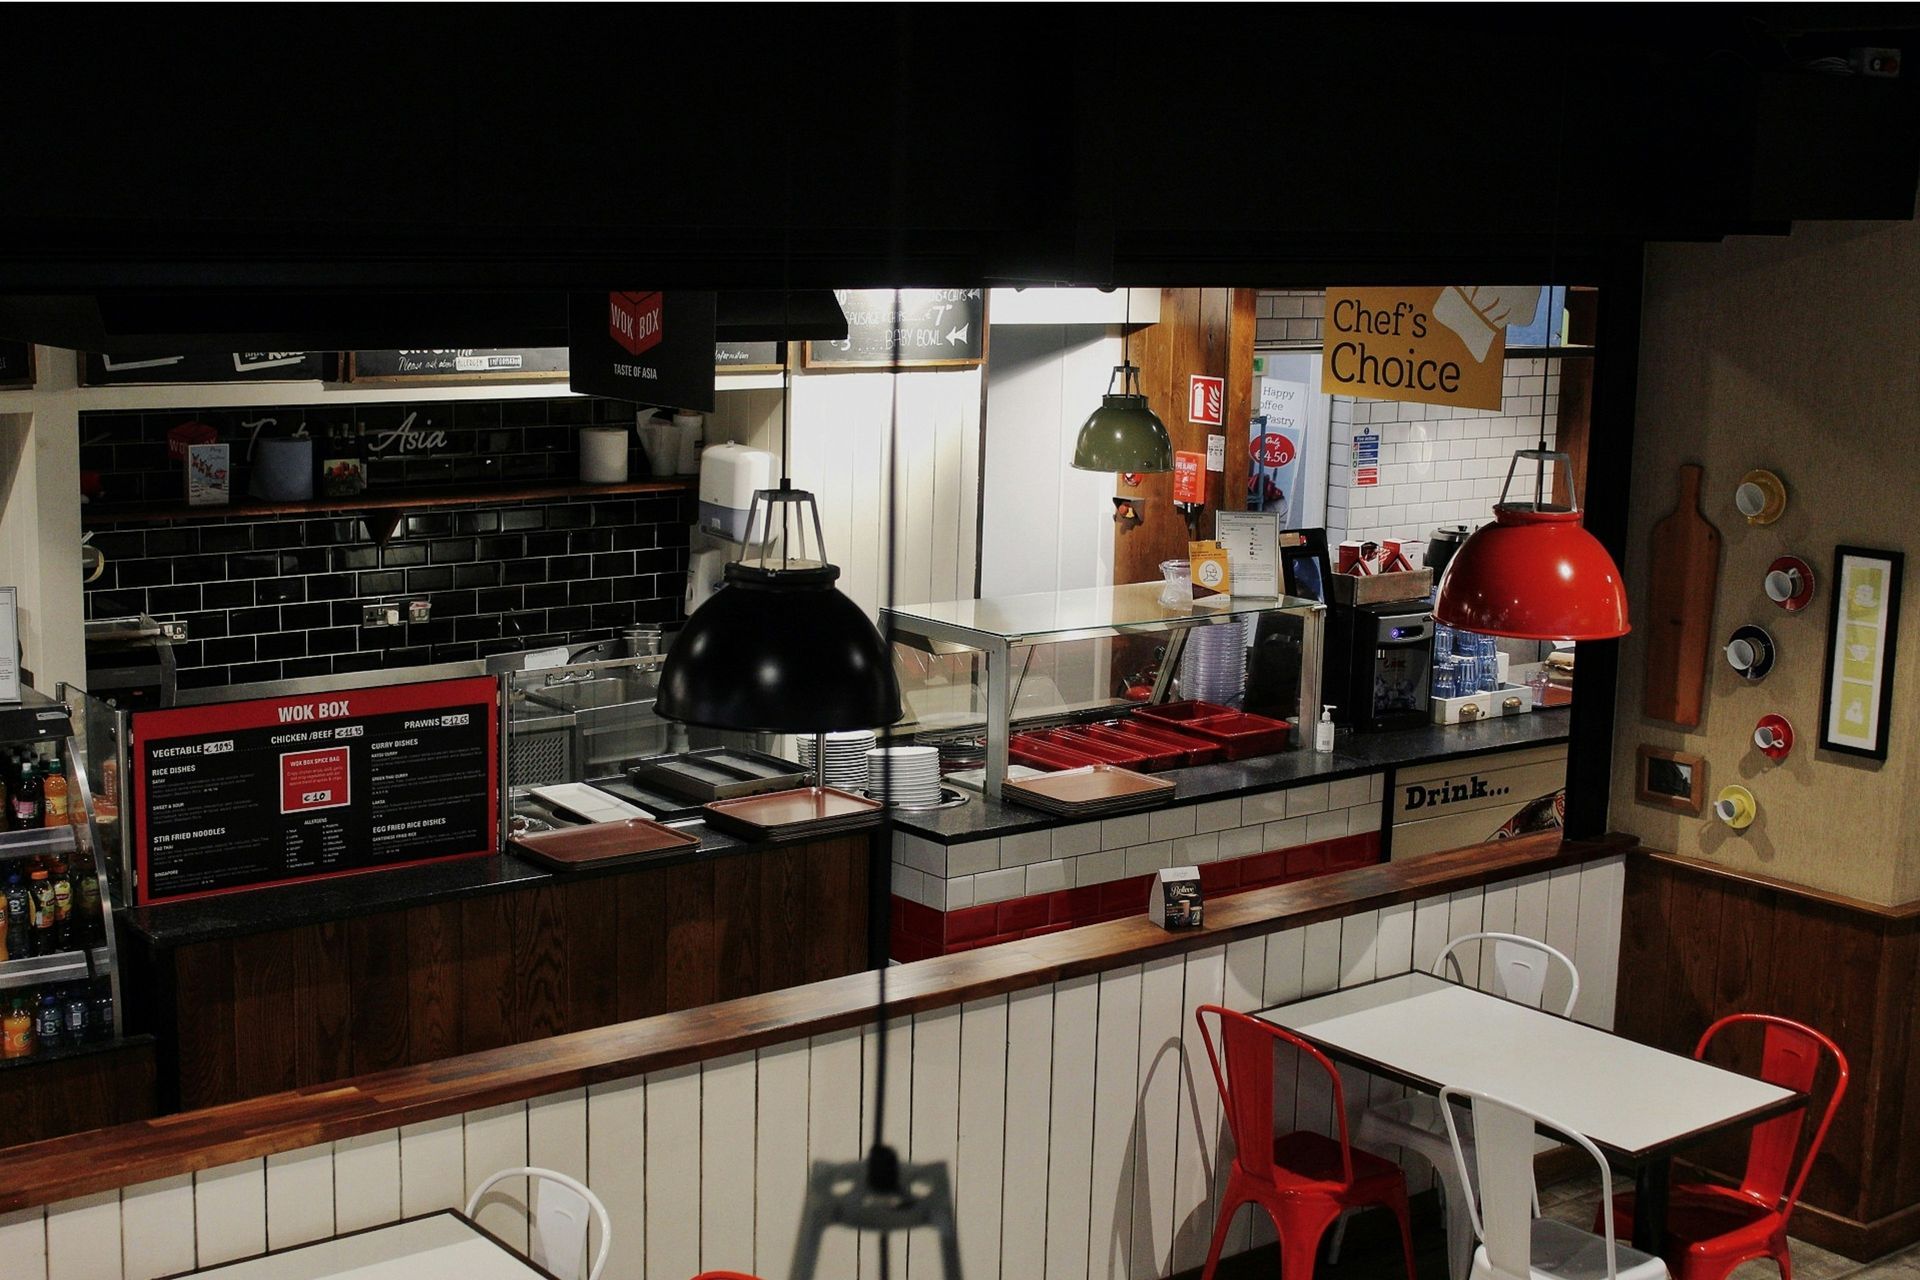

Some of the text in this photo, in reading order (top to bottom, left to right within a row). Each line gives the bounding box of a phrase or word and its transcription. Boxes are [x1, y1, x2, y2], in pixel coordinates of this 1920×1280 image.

[611, 302, 659, 340] WOK BOX
[1333, 299, 1428, 338] Chef's
[916, 328, 943, 348] BOWL
[613, 363, 658, 380] TASTE OF ASIA
[1330, 341, 1461, 393] Choice
[1263, 386, 1295, 401] Happy
[1259, 399, 1284, 411] offee
[1265, 413, 1295, 428] Pastry
[367, 411, 448, 453] Asia
[277, 700, 350, 722] WOK BOX
[404, 718, 440, 729] PRAWNS
[270, 732, 308, 745] CHICKEN
[371, 738, 419, 750] CURRY DISHES
[152, 744, 202, 758] VEGETABLE
[152, 764, 196, 776] RICE DISHES
[1404, 775, 1510, 811] Drink...
[372, 817, 446, 833] EGG FRIED RICE DISHES
[153, 827, 226, 844] STIR FRIED NOODLES
